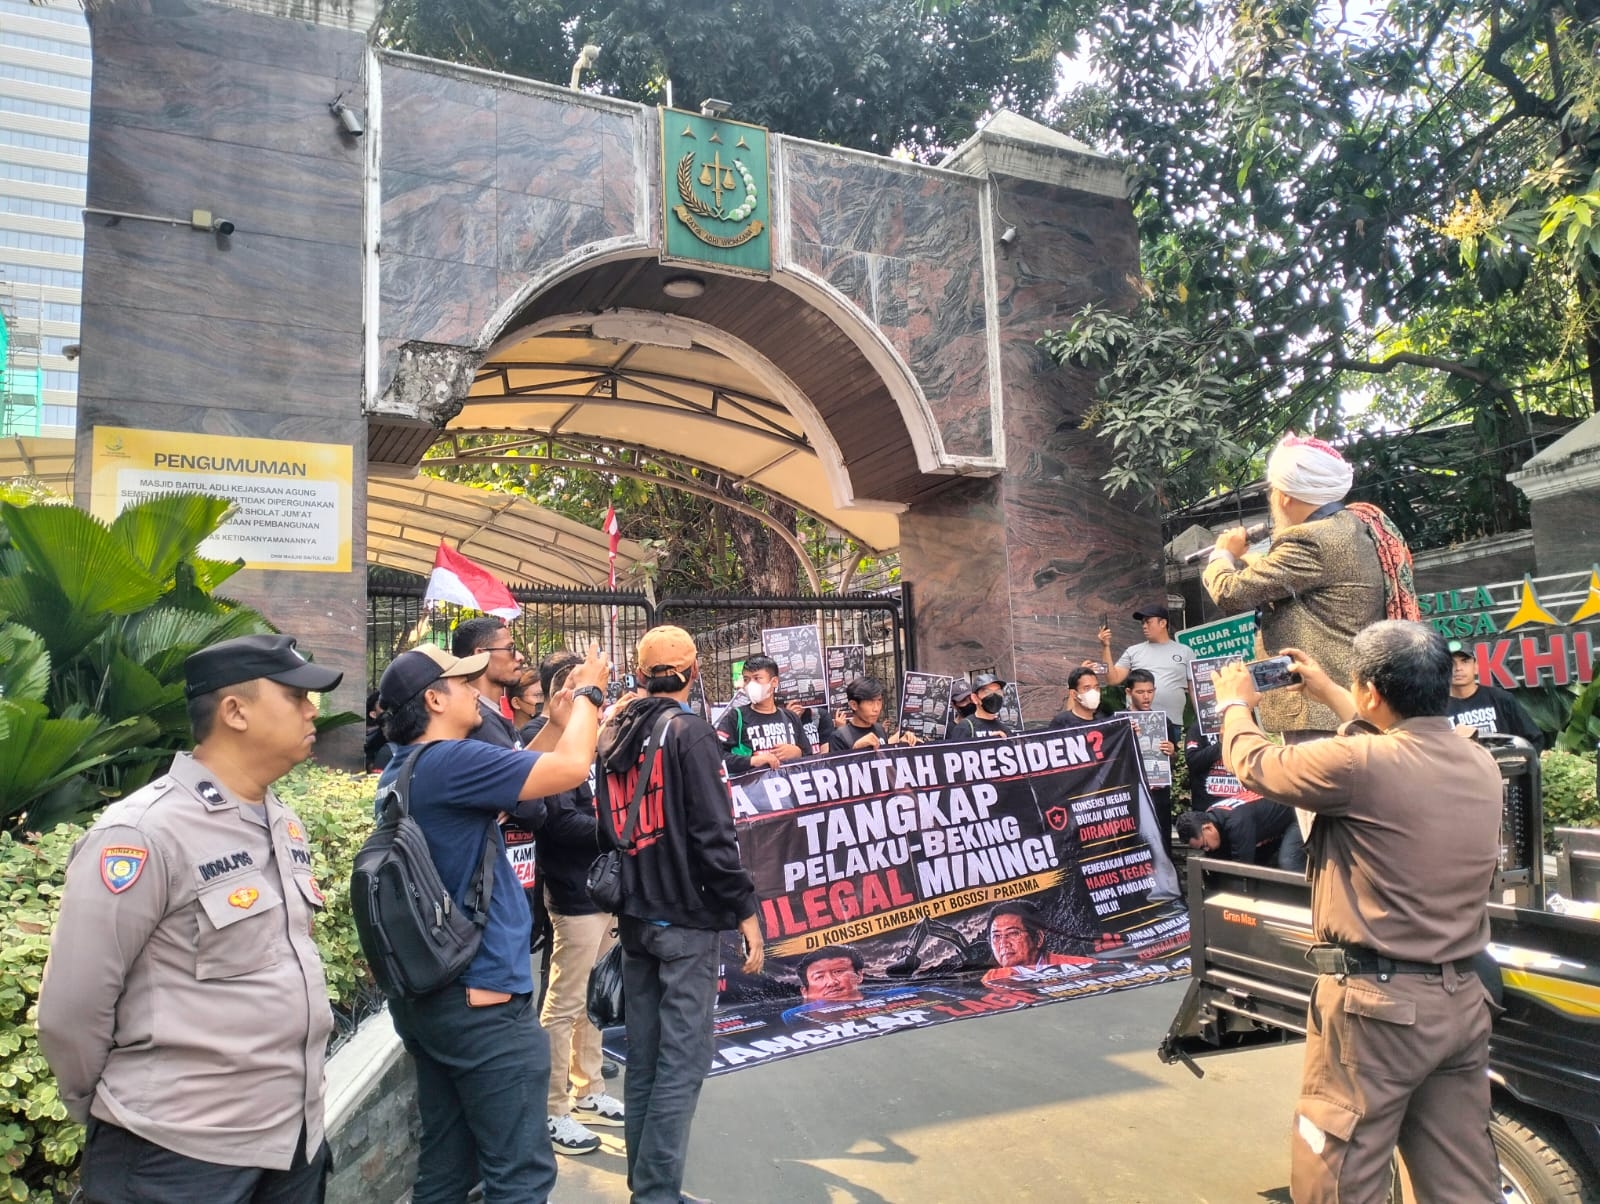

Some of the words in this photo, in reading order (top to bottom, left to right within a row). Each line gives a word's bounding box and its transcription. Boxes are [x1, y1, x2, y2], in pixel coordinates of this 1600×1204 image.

[154, 453, 307, 476] PENGUMUMAN
[140, 479, 174, 488] MASJID
[175, 481, 207, 490] BAITUL
[209, 483, 230, 492] ADLI
[231, 485, 284, 495] KEJAKSAAN
[285, 488, 316, 497] AGUNG
[240, 496, 265, 505] TIDAK
[267, 498, 335, 508] DIPERGUNAKAN
[245, 508, 280, 517] SHOLAT
[253, 520, 320, 529] PEMBANGUNAN
[222, 534, 317, 544] KETIDAKNYAMANANNYA
[1418, 586, 1494, 615] SILA
[1432, 612, 1499, 639] KSA
[1188, 628, 1231, 647] KELUAR
[1193, 644, 1215, 657] ACA
[1217, 635, 1250, 651] PINTU
[1474, 631, 1593, 690] KHI
[1457, 706, 1497, 725] BOSOSI
[746, 725, 760, 740] PT
[731, 784, 759, 818] A
[763, 754, 938, 811] PERINTAH
[943, 730, 1105, 783] PRESIDEN?
[1105, 791, 1132, 806] NEGARA
[797, 784, 998, 856] TANGKAP
[1075, 811, 1102, 826] BUKAN
[1103, 804, 1130, 820] UNTUK
[1080, 816, 1137, 842] DIRAMPOK!
[1081, 857, 1125, 876] PENEGAKAN
[1125, 849, 1152, 865] HUKUM
[761, 868, 914, 940] ILEGAL
[917, 834, 1060, 899] MINING!
[1085, 871, 1120, 890] HARUS
[1089, 886, 1117, 904] TANPA
[1117, 877, 1157, 896] PANDANG
[805, 936, 819, 950] DI
[822, 922, 873, 947] KONSESI
[875, 904, 931, 930] TAMBANG
[933, 900, 947, 913] PT
[949, 889, 990, 909] BOSOSI
[993, 878, 1040, 899] PRATAMA
[1095, 900, 1120, 916] BULU!
[1223, 909, 1241, 922] Gran
[1240, 913, 1257, 927] Max
